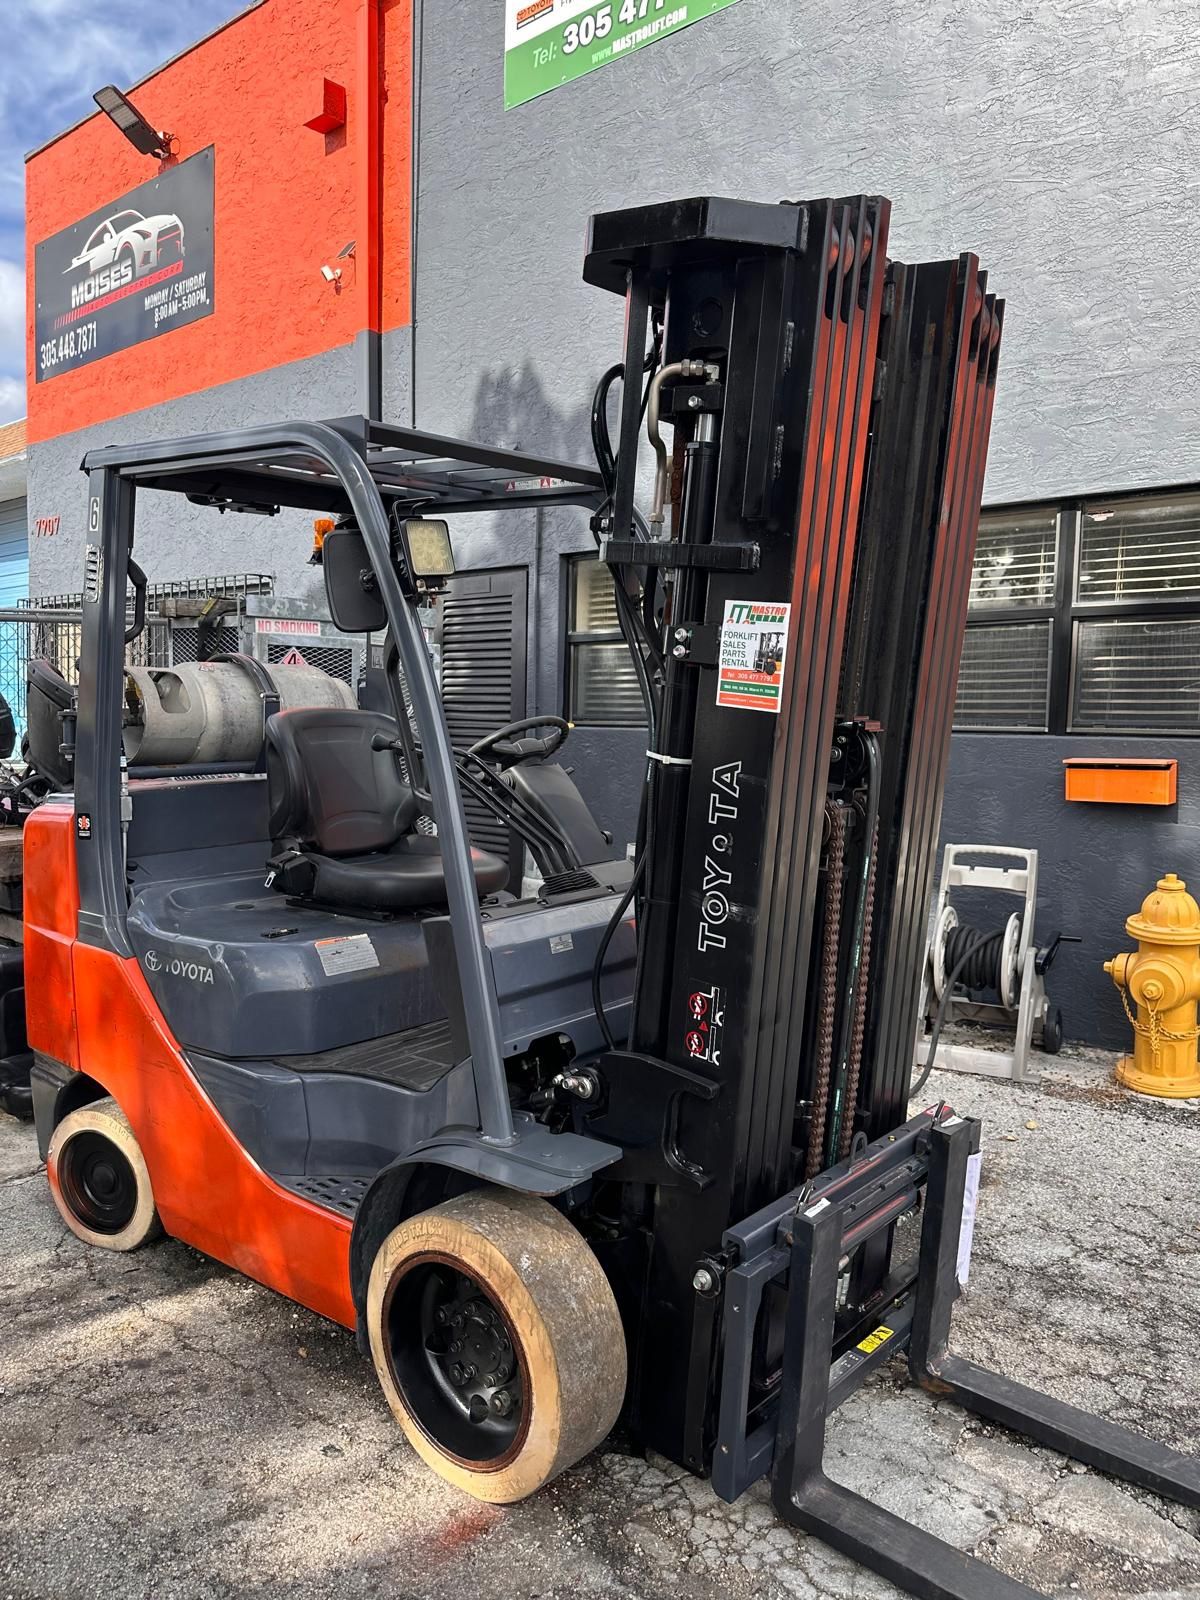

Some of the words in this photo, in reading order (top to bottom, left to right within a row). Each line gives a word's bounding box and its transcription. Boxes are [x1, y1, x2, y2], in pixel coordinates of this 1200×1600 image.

[533, 41, 557, 68] Tel:
[562, 4, 613, 56] 305
[618, 0, 666, 25] 47
[71, 258, 132, 309] MOISES
[144, 287, 168, 311] MONDAY
[174, 271, 207, 298] SATURDAY
[40, 320, 97, 370] 305.448.7871
[35, 515, 61, 538] 7907
[751, 605, 787, 616] MASTRO
[257, 620, 272, 633] NO
[274, 620, 319, 634] SMOKING
[723, 630, 759, 641] FORKLIFT
[722, 640, 746, 650] SALES
[722, 649, 746, 659] PARTS
[721, 657, 749, 668] RENTAL
